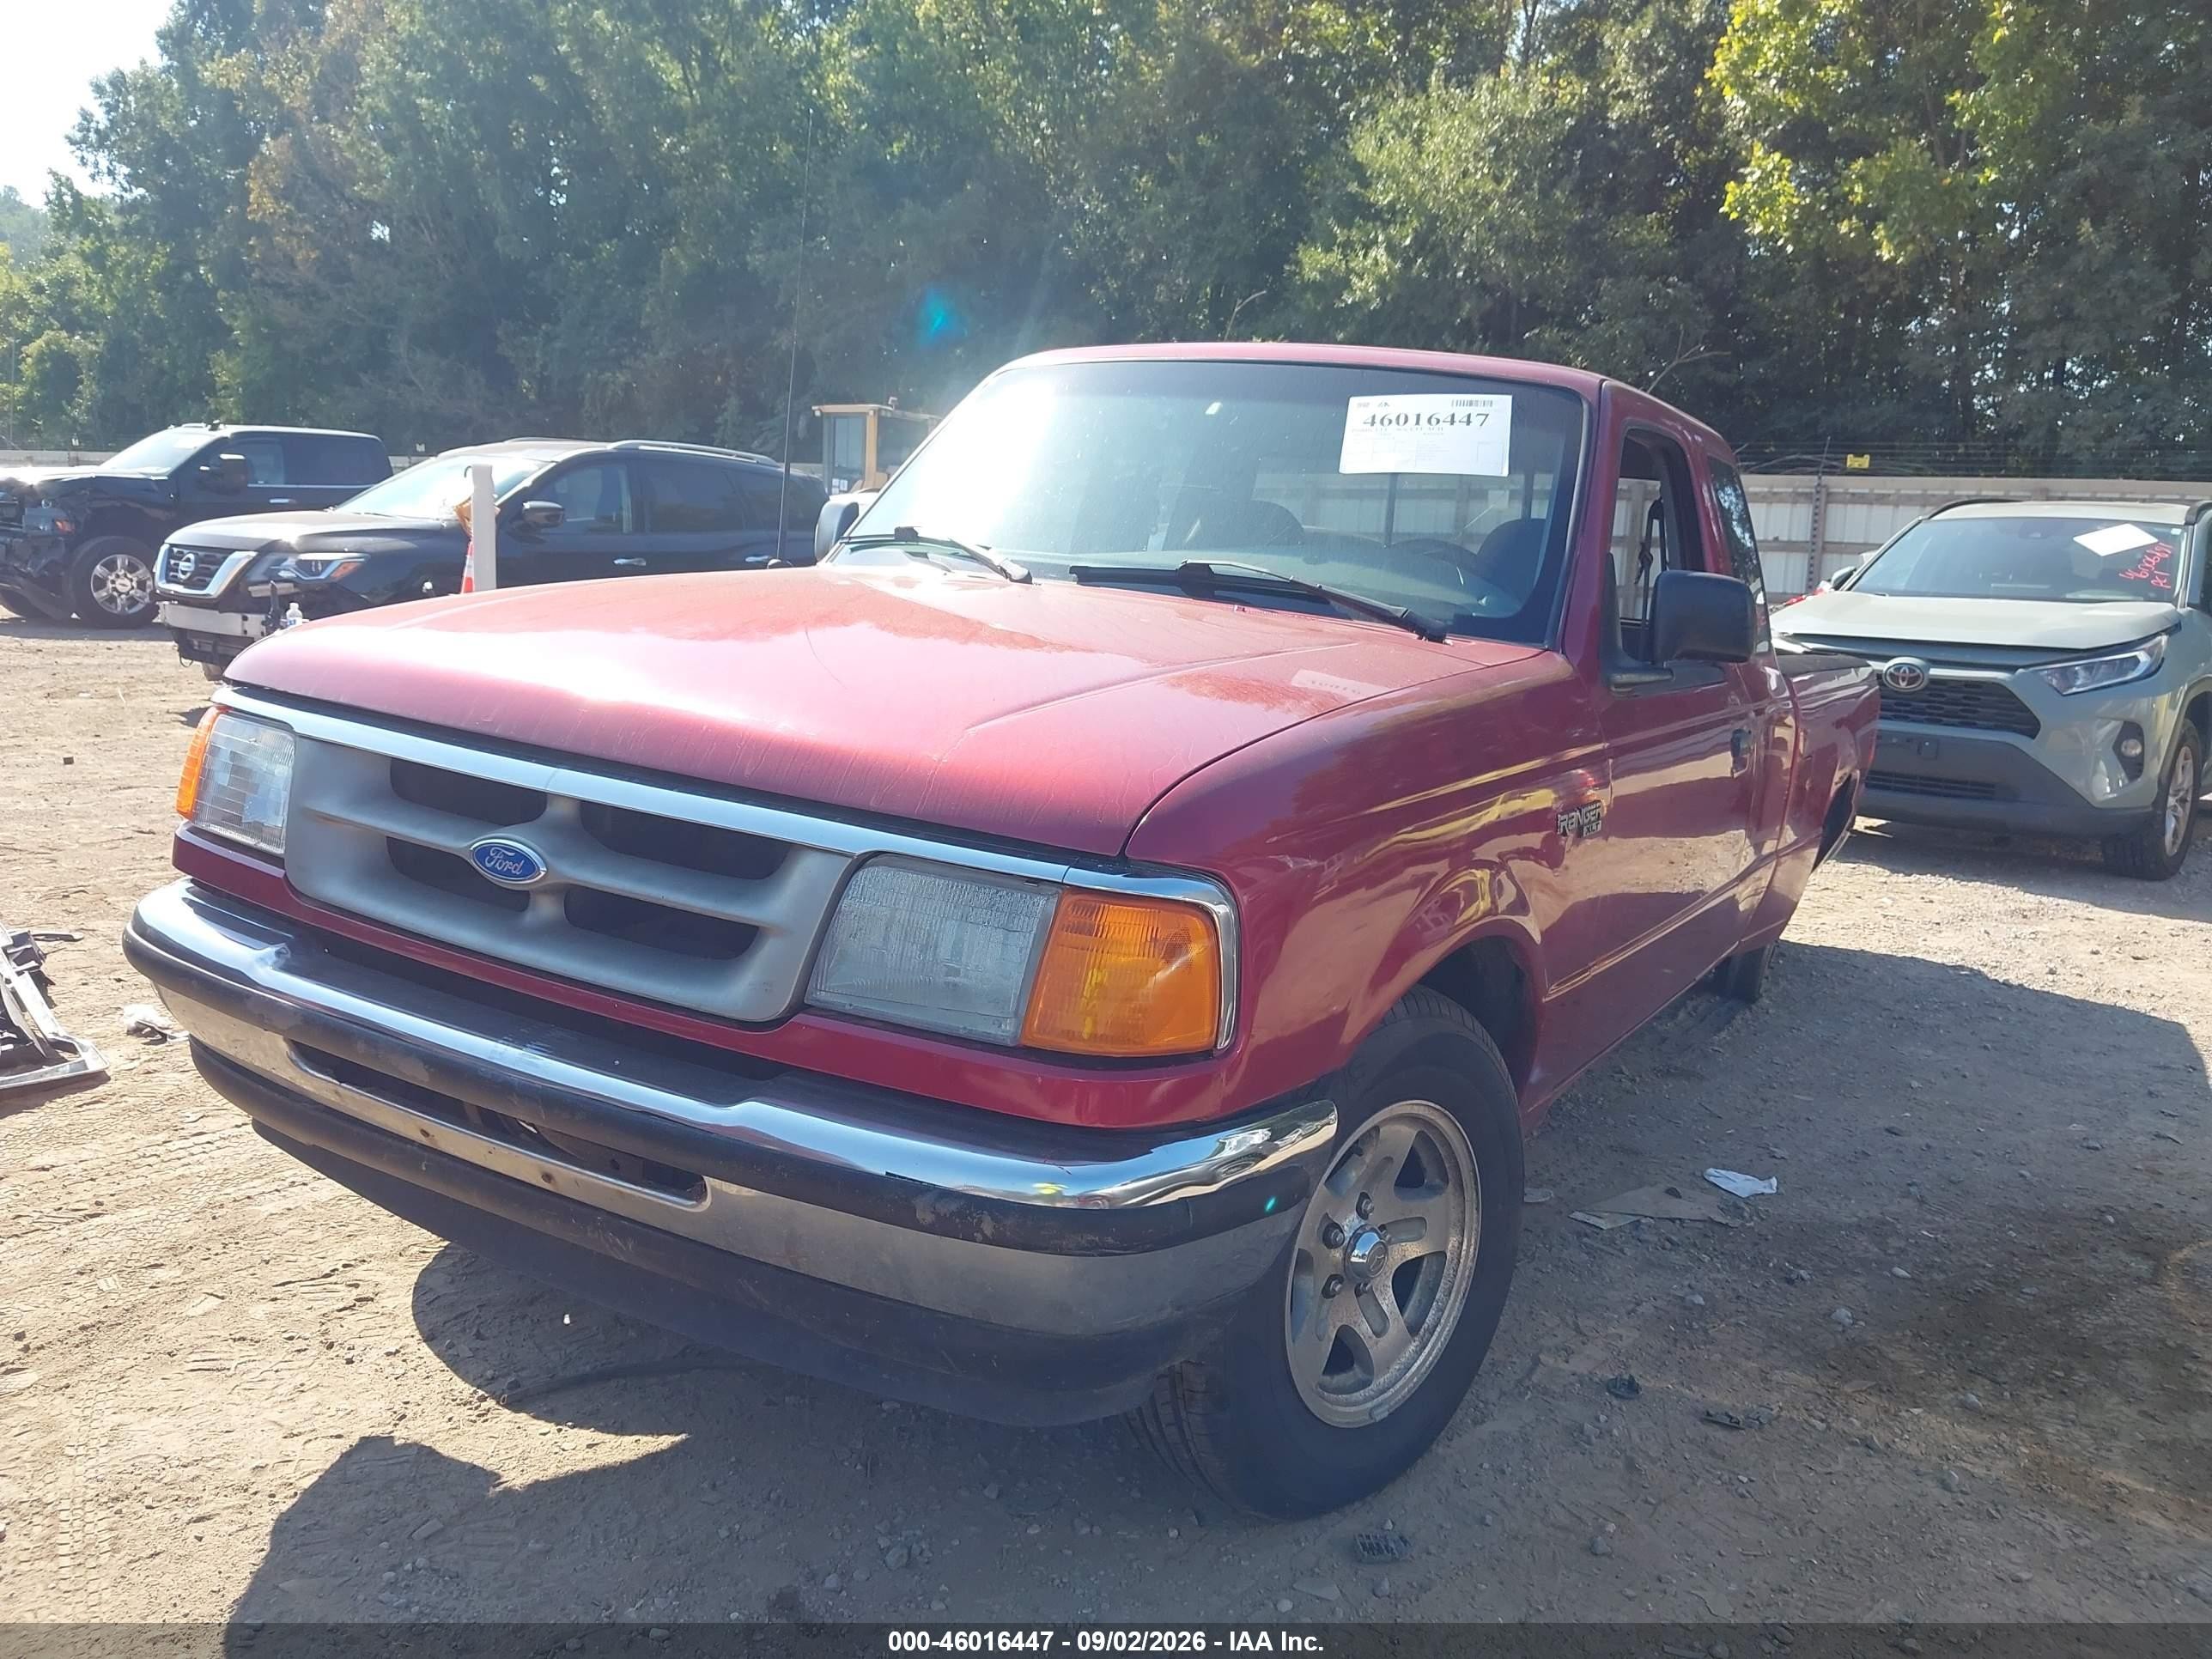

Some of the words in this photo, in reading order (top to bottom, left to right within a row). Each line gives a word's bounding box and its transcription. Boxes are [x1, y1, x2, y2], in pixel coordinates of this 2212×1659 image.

[1363, 412, 1490, 427] 46016447
[1558, 803, 1601, 836] RANGER
[1583, 821, 1601, 836] XLT
[485, 847, 525, 875] Ford
